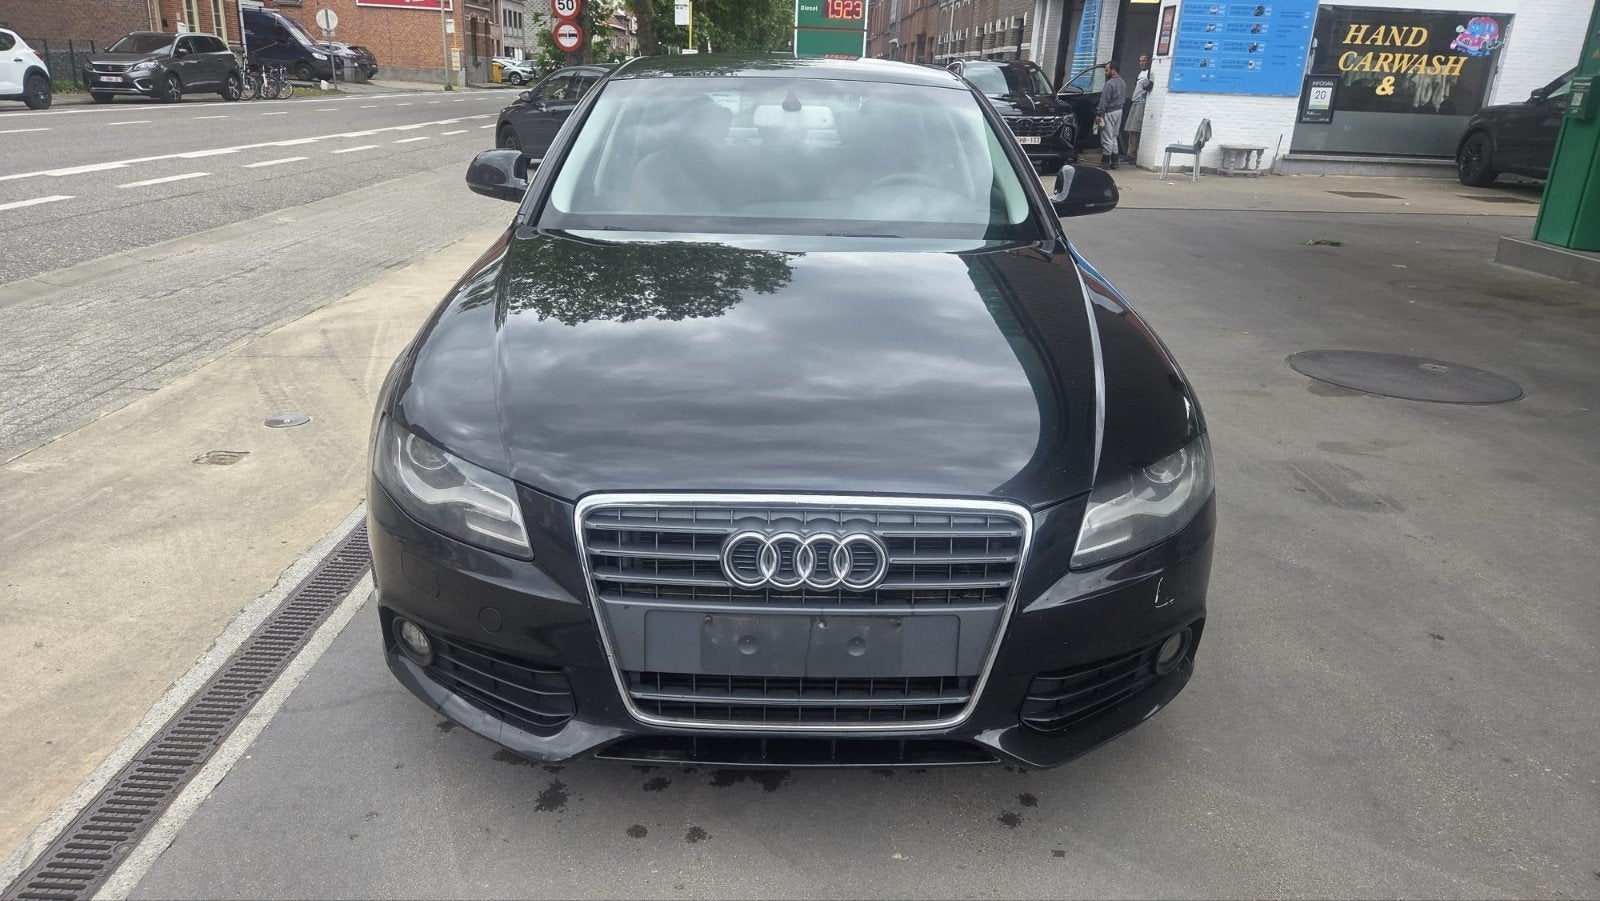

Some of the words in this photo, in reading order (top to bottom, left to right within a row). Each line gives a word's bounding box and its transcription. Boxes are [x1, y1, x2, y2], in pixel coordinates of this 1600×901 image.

[557, 0, 574, 10] 50
[827, 0, 863, 19] 1.923
[1342, 24, 1428, 47] HAND
[1338, 51, 1468, 76] CARWASH
[1315, 90, 1327, 100] 20
[1375, 76, 1396, 96] &
